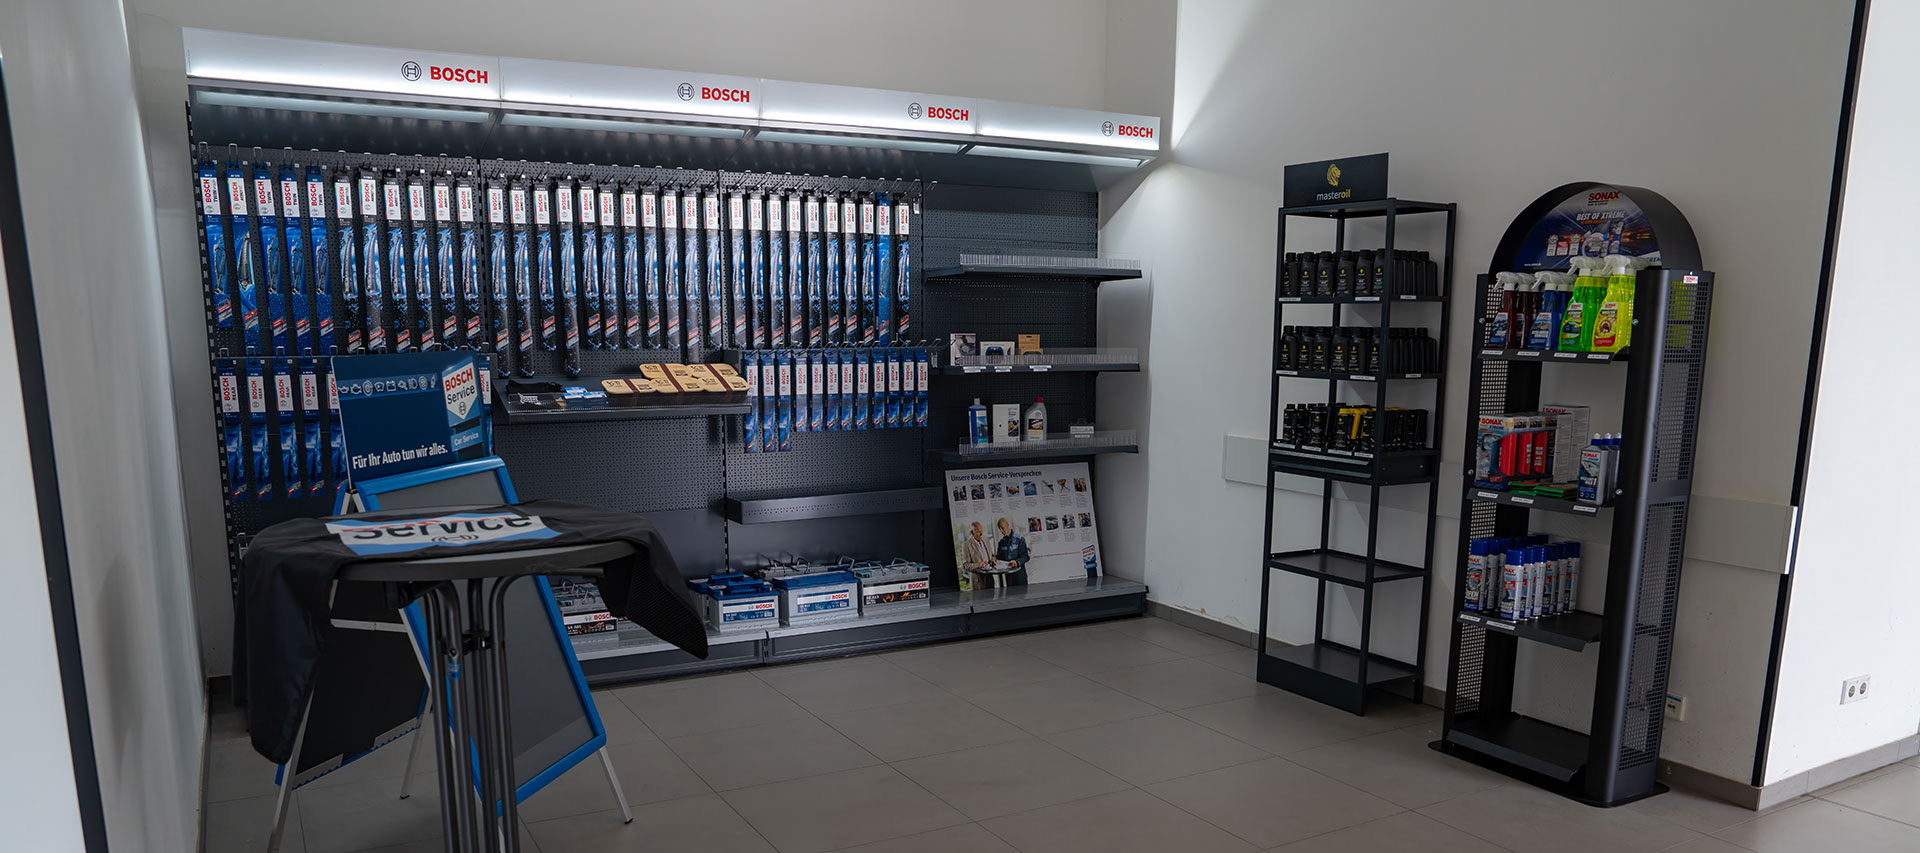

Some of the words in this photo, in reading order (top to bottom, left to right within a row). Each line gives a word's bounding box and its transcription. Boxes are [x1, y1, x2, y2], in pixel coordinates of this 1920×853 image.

[429, 65, 489, 85] BOSCH
[701, 86, 750, 104] BOSCH
[927, 106, 969, 121] BOSCH
[1118, 125, 1153, 139] BOSCH
[203, 178, 212, 203] BOSCH
[231, 181, 239, 202] BOSCH
[257, 180, 267, 205] BOSCH
[283, 182, 292, 207] BOSCH
[309, 183, 318, 207] BOSCH
[1316, 189, 1351, 201] masteroil
[1588, 191, 1620, 201] SONAX
[1576, 212, 1591, 221] BEST
[1591, 212, 1600, 220] OF
[1600, 210, 1626, 219] XTREME
[221, 377, 231, 401] BOSCH
[250, 379, 258, 401] BOSCH
[278, 378, 286, 399] BOSCH
[444, 367, 473, 392] BOSCH
[446, 384, 476, 405] Service
[1481, 417, 1503, 425] SONAX
[453, 437, 462, 446] Car
[462, 432, 479, 443] Service
[352, 454, 367, 469] Für
[368, 452, 381, 467] Ihr
[382, 451, 401, 464] Auto
[401, 448, 416, 461] tun
[416, 444, 428, 458] wir
[429, 442, 448, 456] alles.
[950, 474, 971, 482] Unsere
[970, 473, 988, 481] Bosch
[987, 470, 1042, 480] Service-Versprechen
